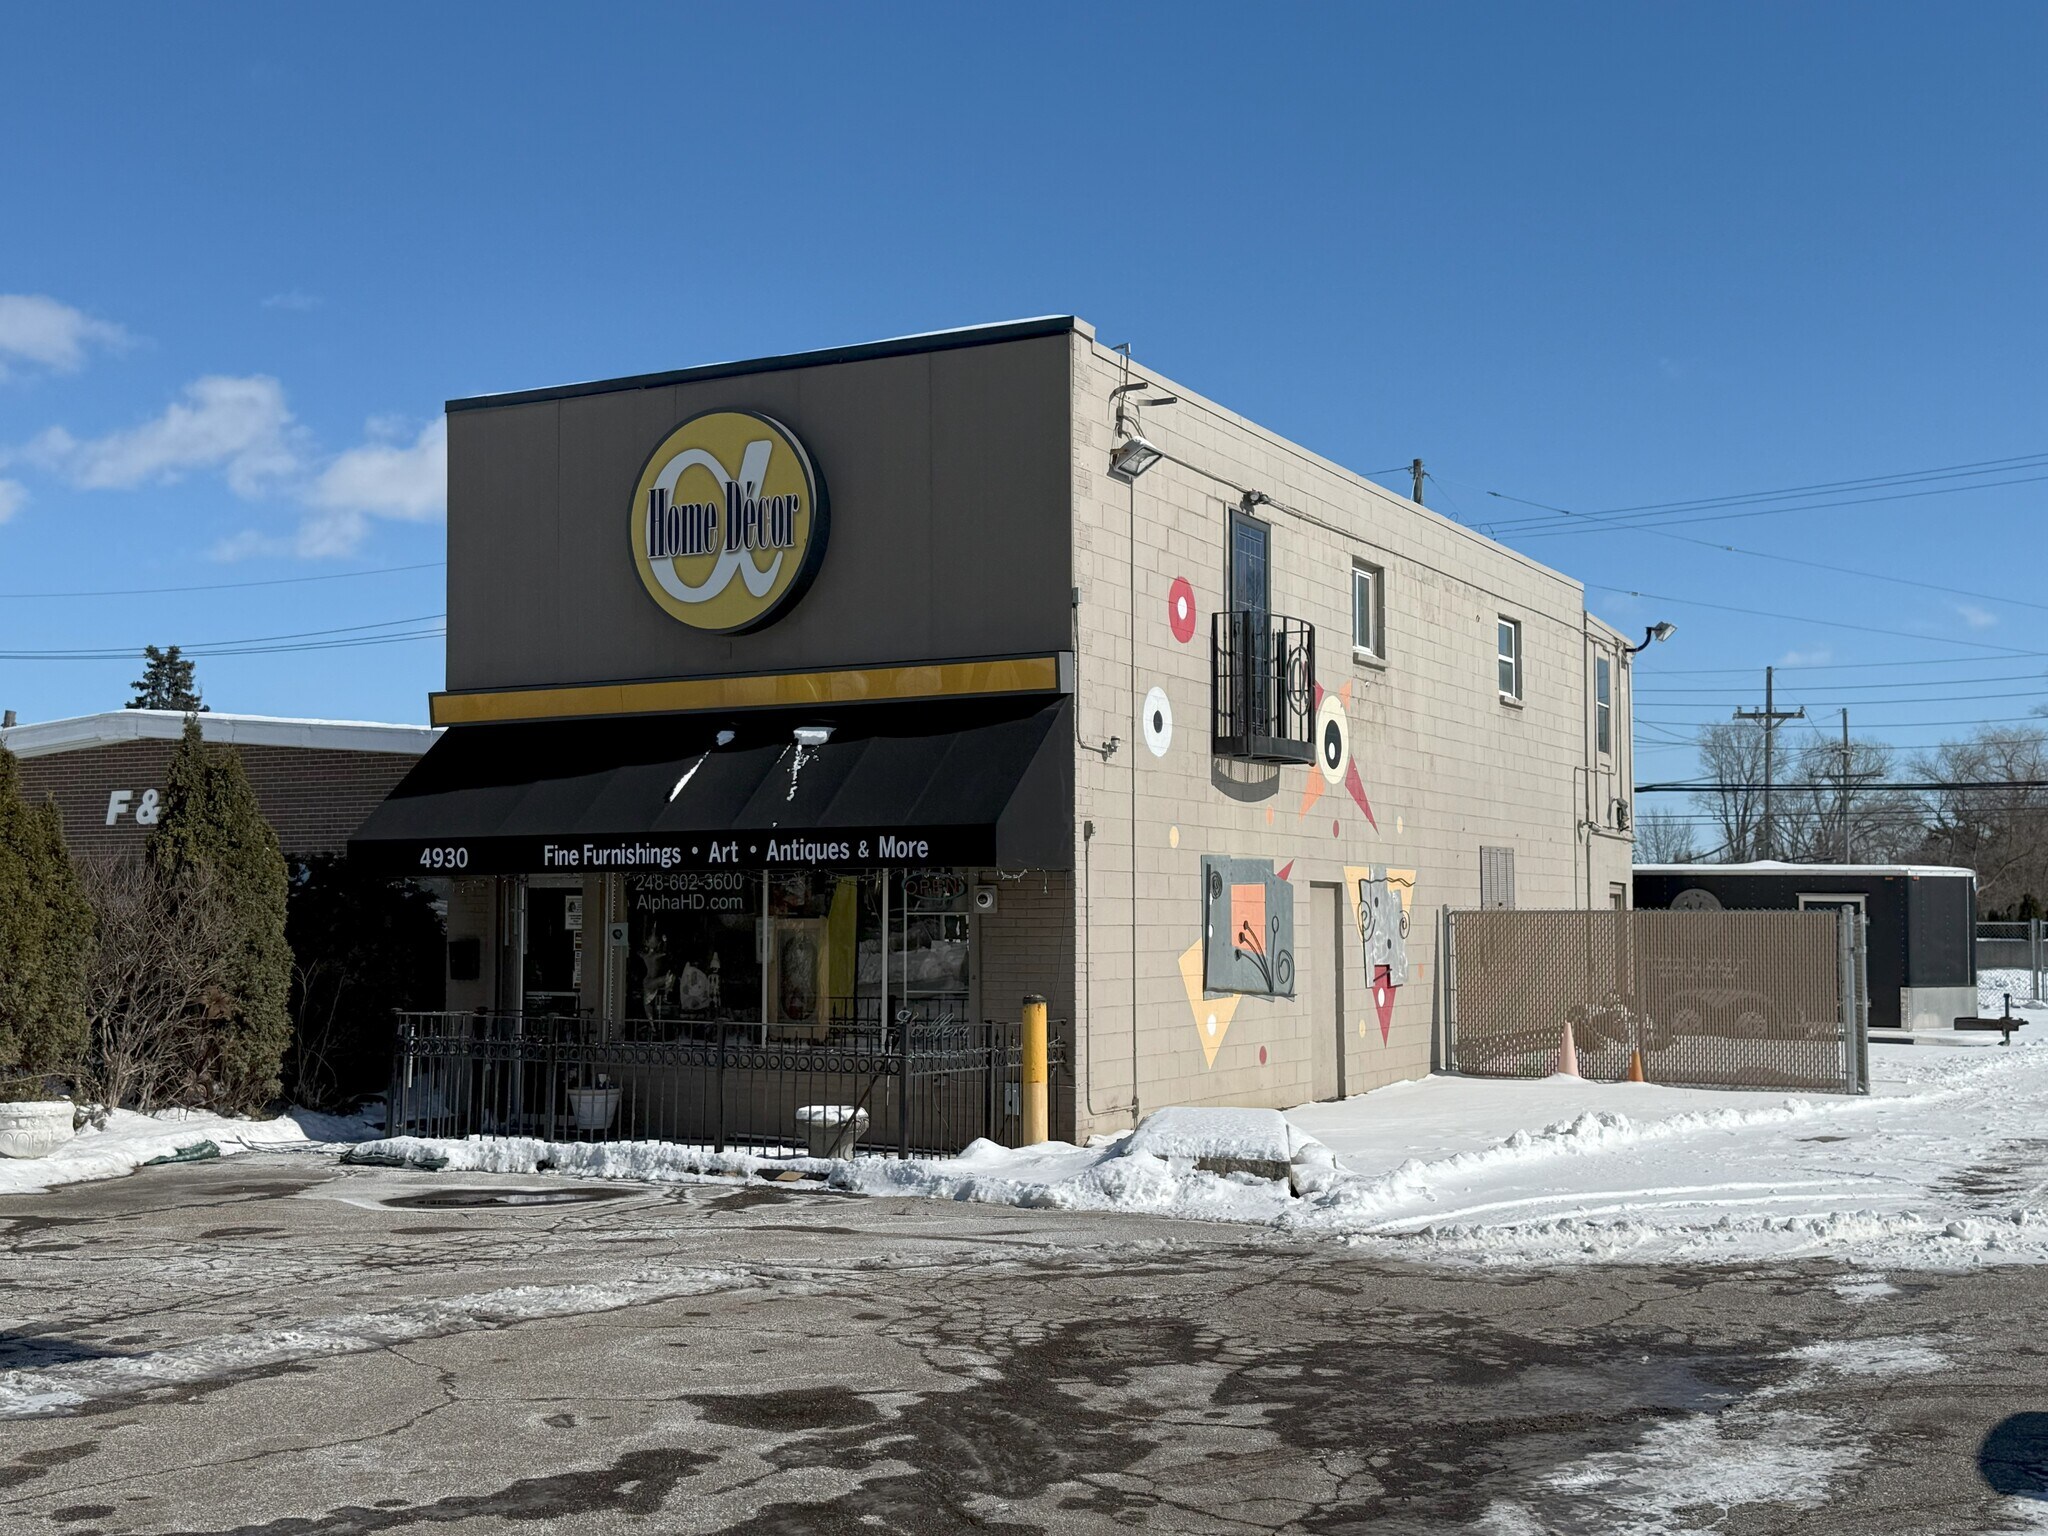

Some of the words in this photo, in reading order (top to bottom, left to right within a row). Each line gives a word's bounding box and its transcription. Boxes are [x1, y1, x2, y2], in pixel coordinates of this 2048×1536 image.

[647, 486, 719, 560] Home
[724, 480, 800, 553] Décor
[105, 790, 134, 826] F
[136, 788, 162, 825] &
[419, 847, 469, 868] 4930
[544, 844, 580, 866] Fine
[583, 842, 682, 868] Furnishings
[708, 840, 739, 863] Art
[766, 838, 850, 865] Antiques
[857, 840, 870, 858] &
[878, 835, 929, 858] More
[635, 873, 743, 891] 248-602-3600
[905, 878, 960, 896] OPEN
[635, 894, 743, 914] AlphaHD.com
